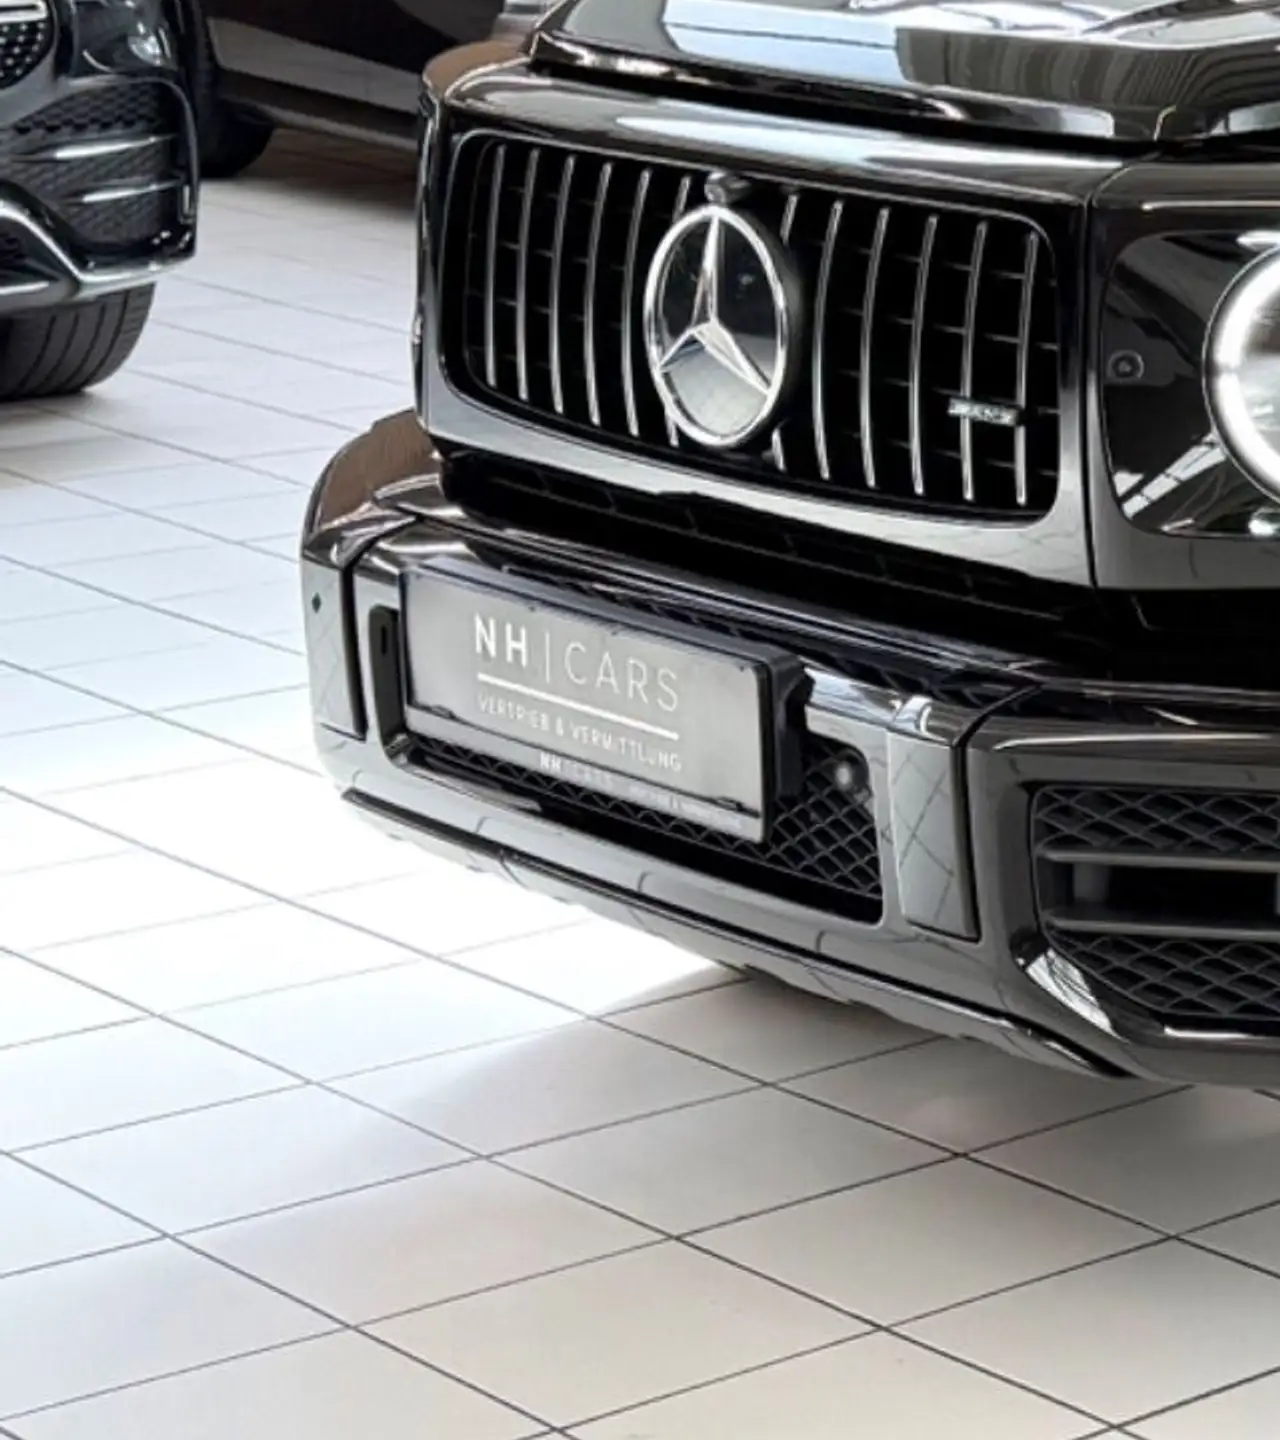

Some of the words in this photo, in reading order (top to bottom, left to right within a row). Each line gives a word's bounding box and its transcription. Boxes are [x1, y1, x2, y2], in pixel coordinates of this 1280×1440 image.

[473, 612, 528, 669] NH
[564, 641, 679, 712] CARS
[479, 691, 549, 732] VERTREB
[568, 720, 682, 773] VERMTTLNG
